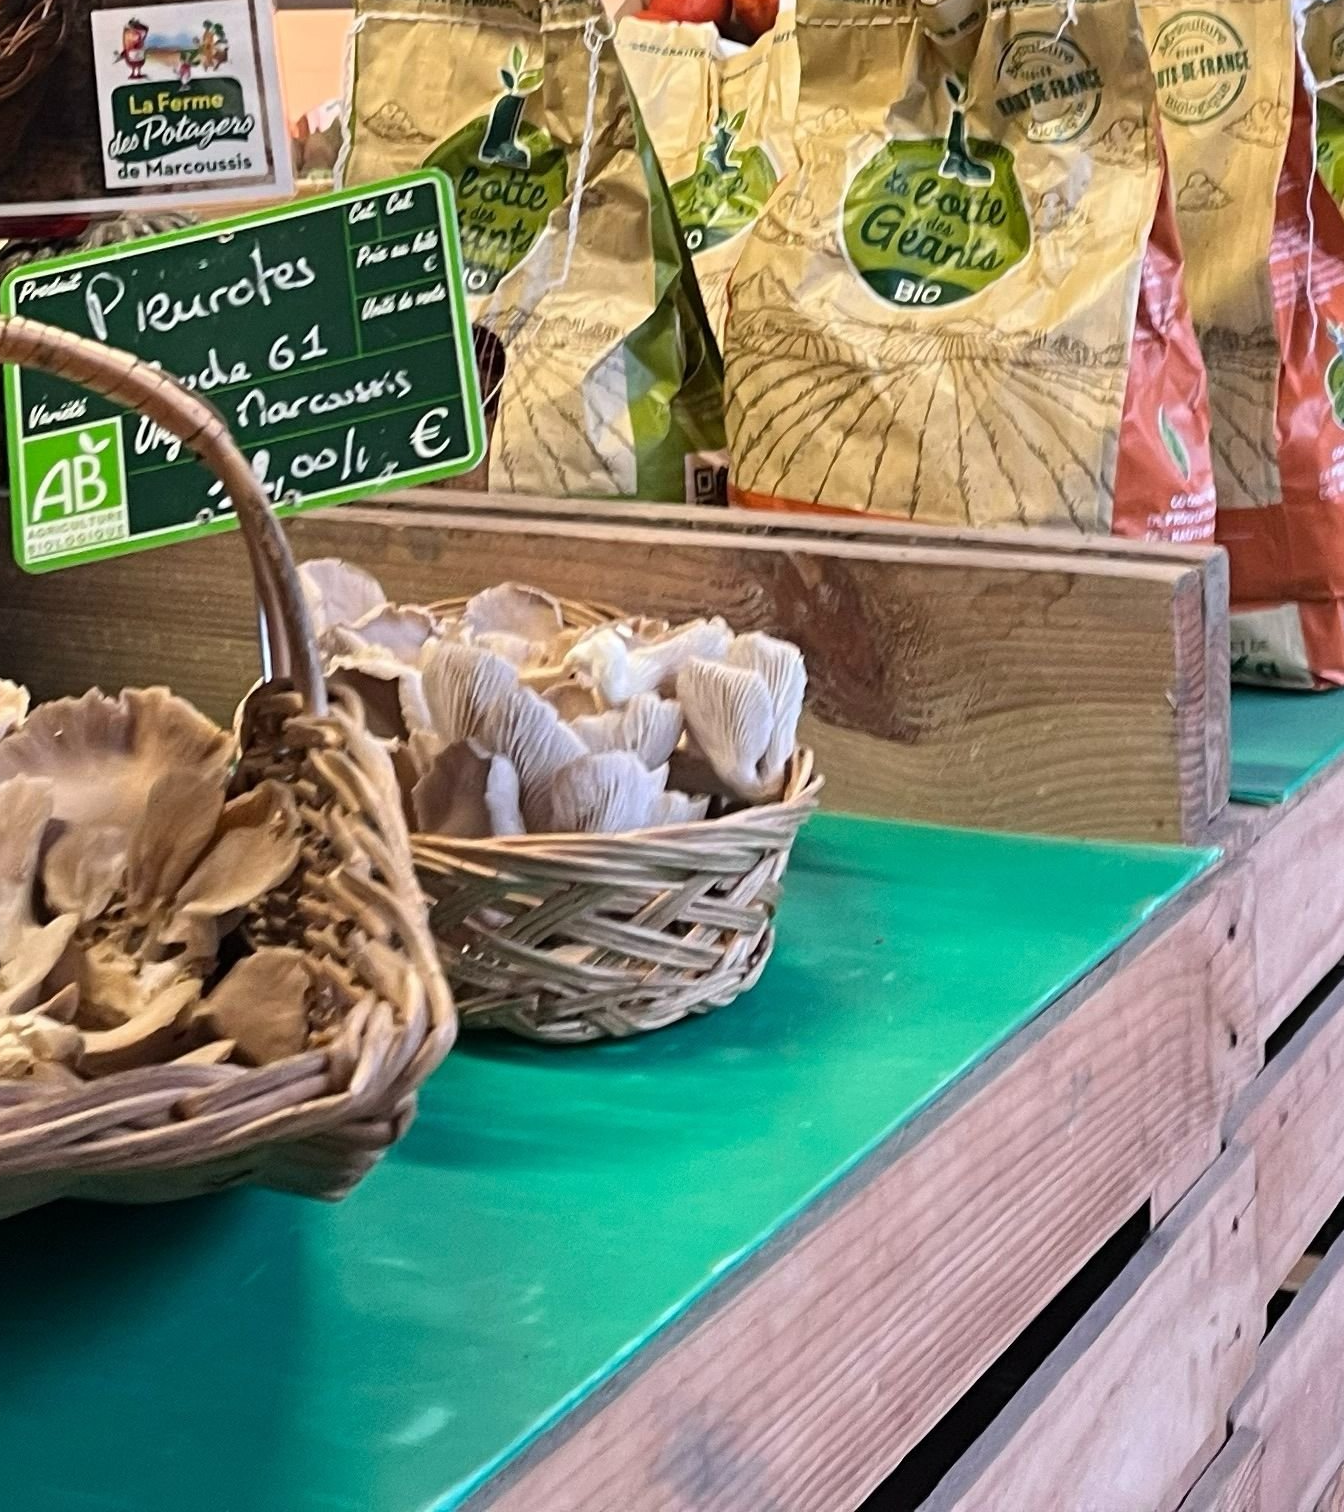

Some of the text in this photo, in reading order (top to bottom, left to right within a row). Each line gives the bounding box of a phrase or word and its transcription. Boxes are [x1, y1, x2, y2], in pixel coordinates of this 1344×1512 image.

[129, 91, 225, 115] La Ferme
[109, 113, 255, 158] des Potagers
[117, 152, 253, 180] de Marcoussis
[893, 277, 943, 305] BIO
[409, 407, 451, 459] €
[31, 451, 108, 523] AB
[26, 510, 125, 542] AGRICULTURE
[26, 526, 126, 557] BIOLOGIQUE
